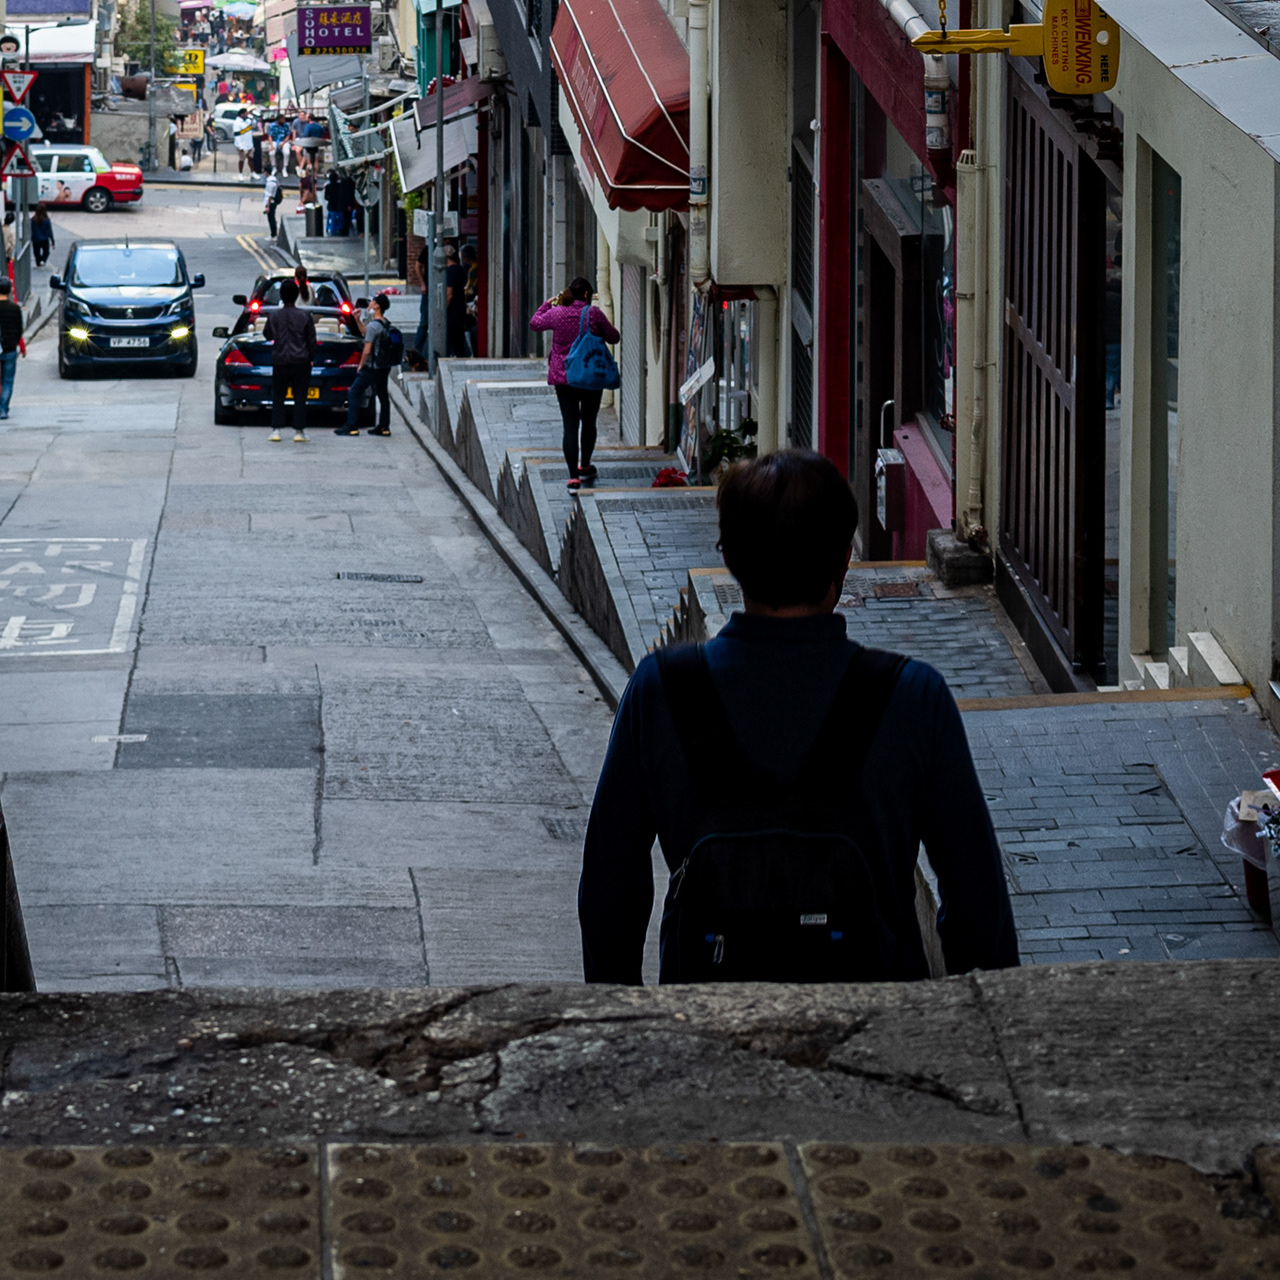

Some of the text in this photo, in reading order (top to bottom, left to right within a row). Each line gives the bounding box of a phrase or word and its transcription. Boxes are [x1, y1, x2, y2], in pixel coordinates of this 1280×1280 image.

[304, 9, 315, 47] SOHO
[1051, 16, 1059, 65] MACHINES
[1061, 30, 1069, 72] CUTTING
[1075, 17, 1092, 84] WENXING
[1100, 55, 1109, 82] HERE
